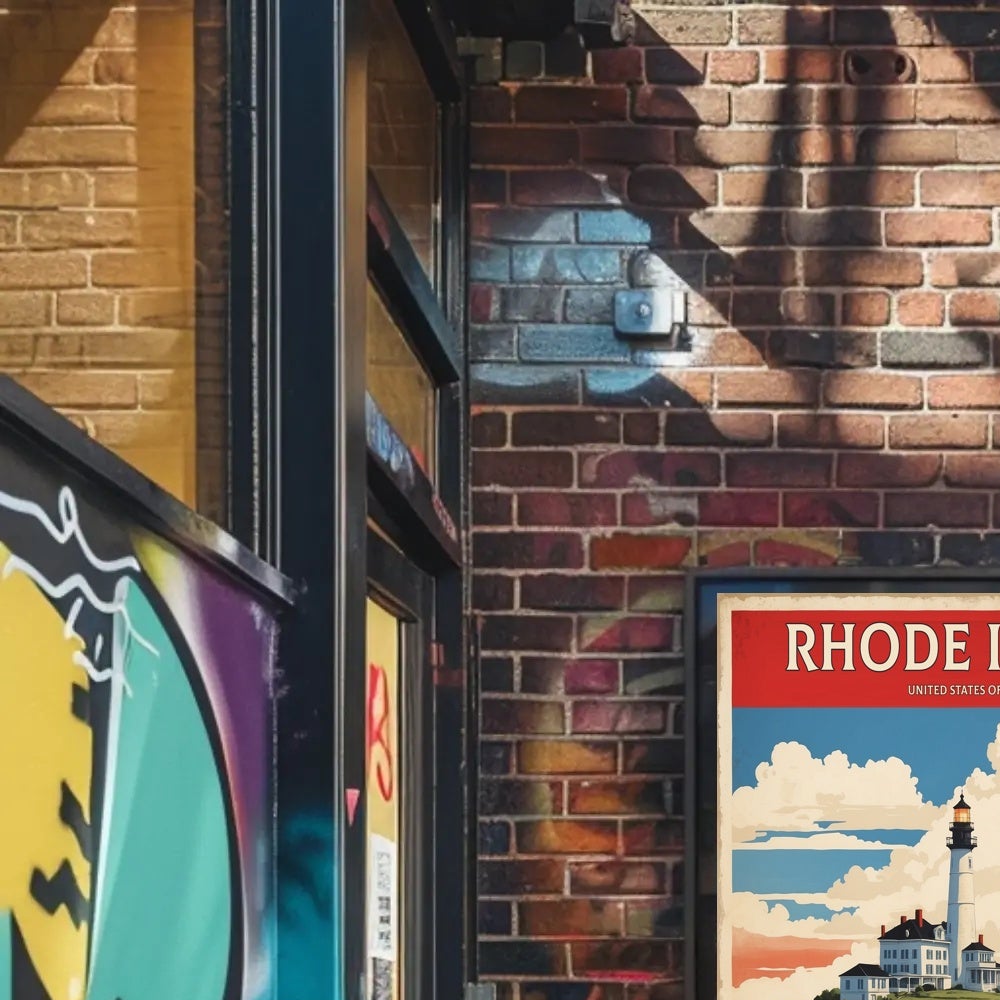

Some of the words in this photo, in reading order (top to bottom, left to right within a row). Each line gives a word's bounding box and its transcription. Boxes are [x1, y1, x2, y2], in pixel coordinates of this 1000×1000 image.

[785, 621, 972, 673] RHODE
[907, 684, 948, 696] UNITED
[949, 684, 986, 696] STATES
